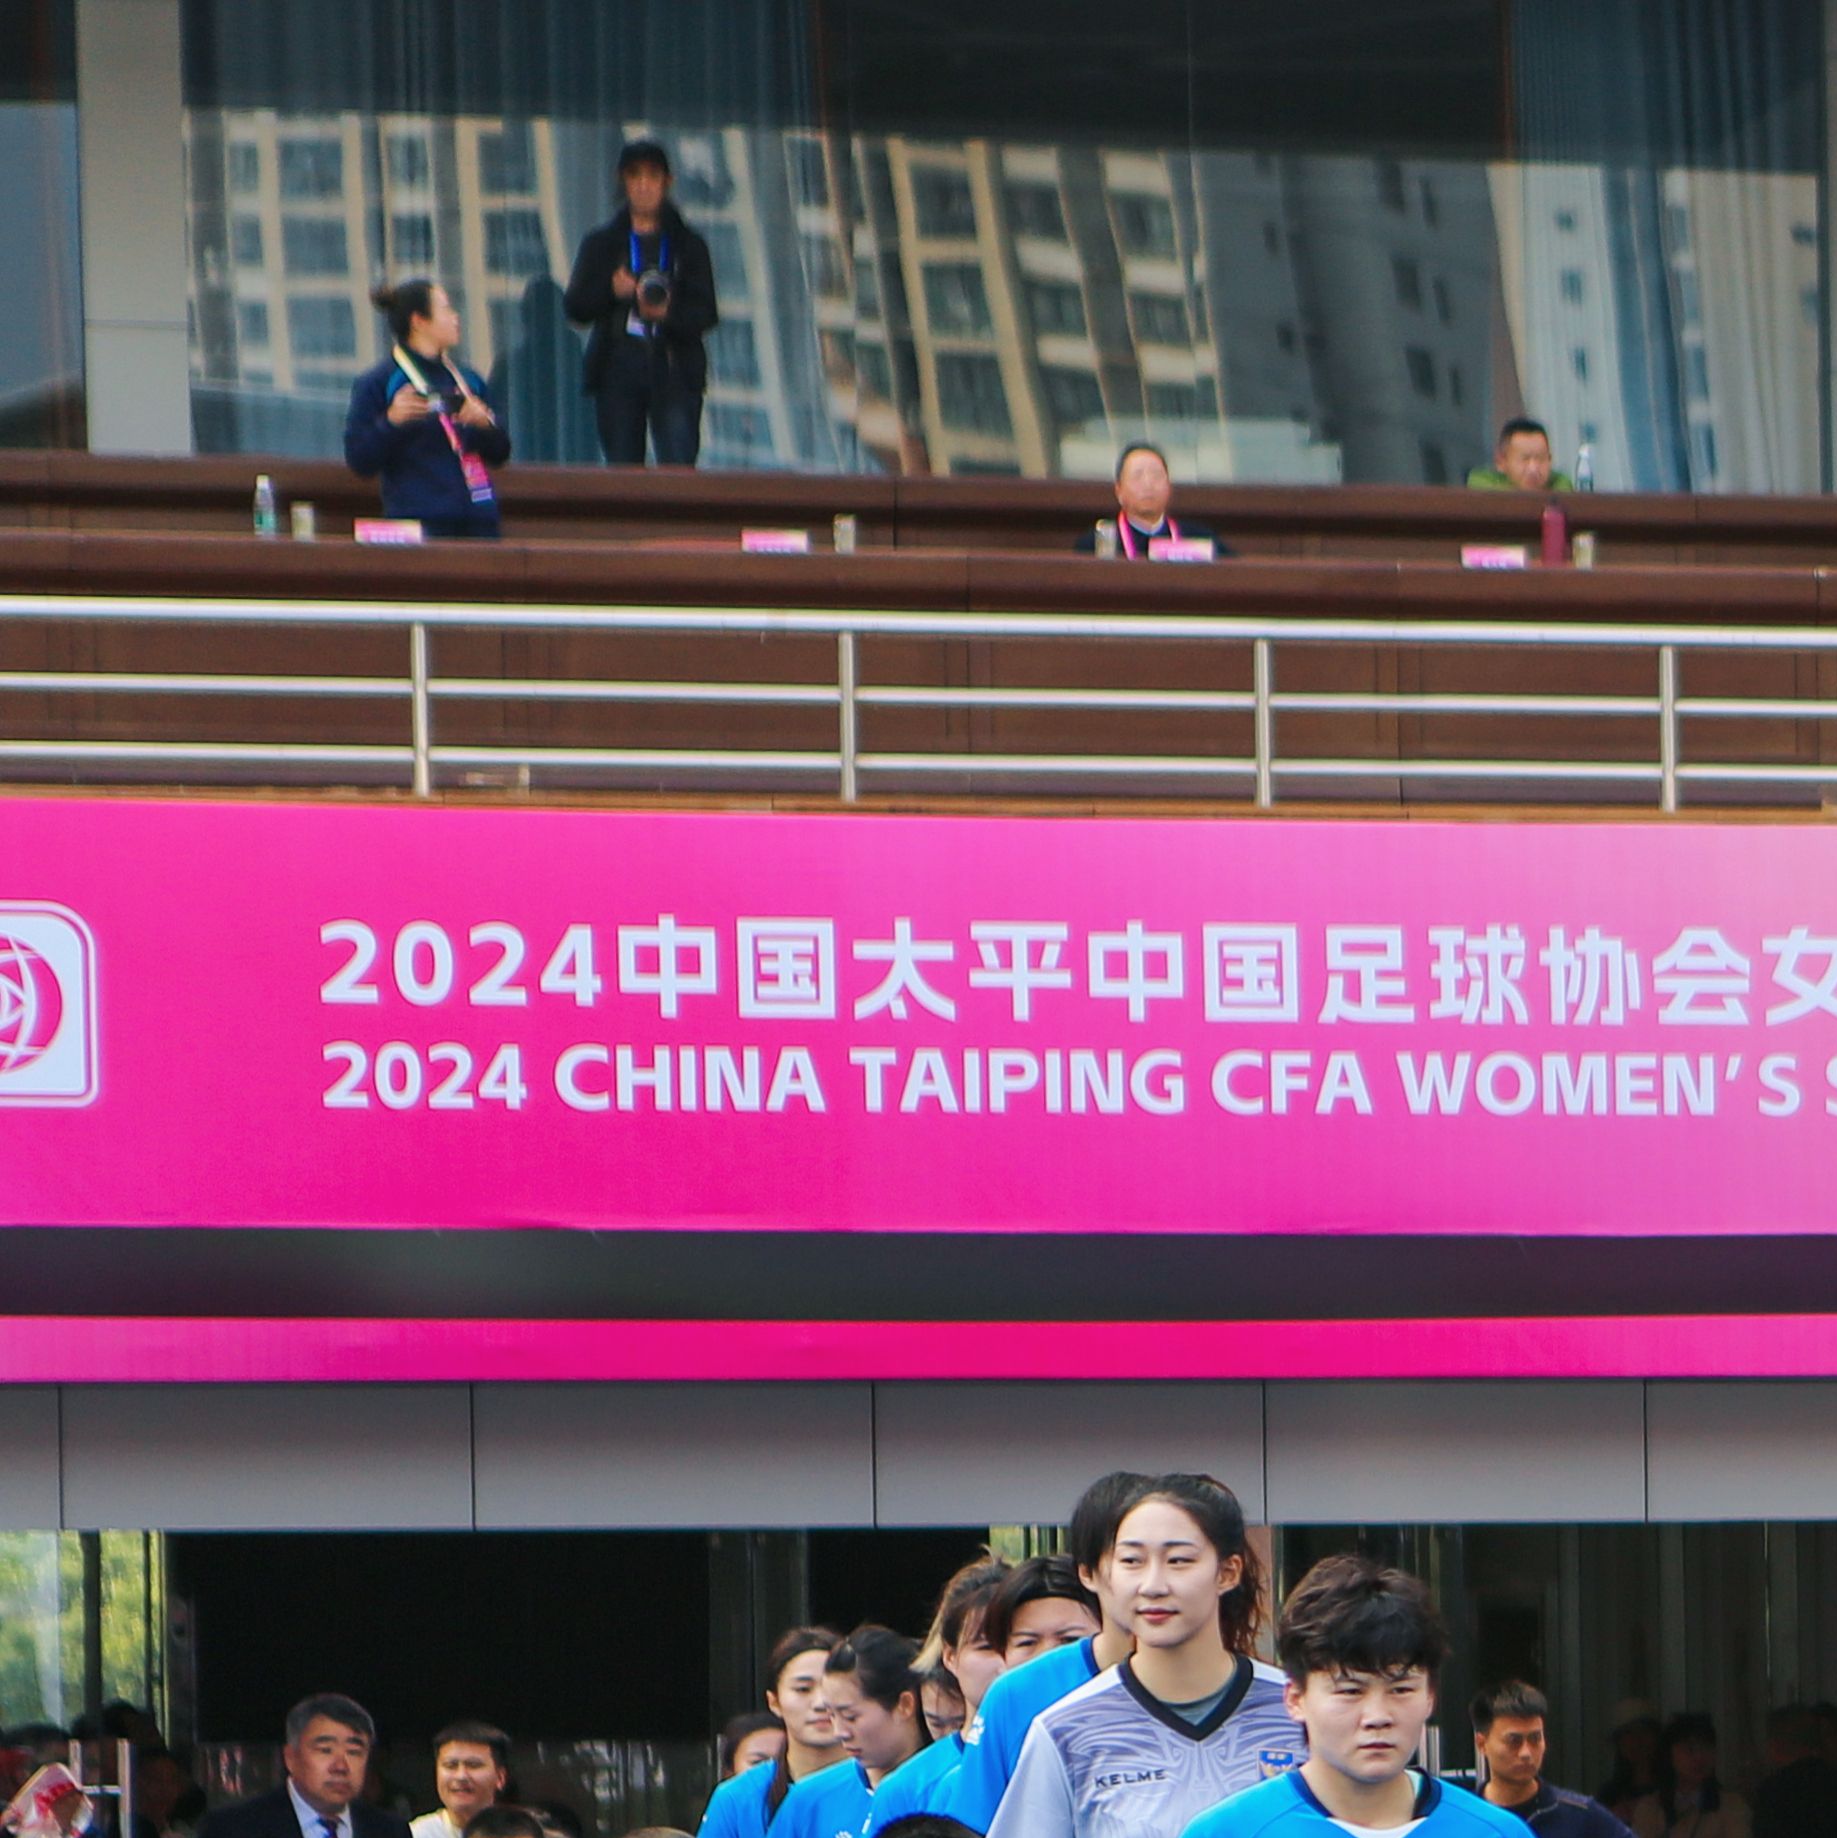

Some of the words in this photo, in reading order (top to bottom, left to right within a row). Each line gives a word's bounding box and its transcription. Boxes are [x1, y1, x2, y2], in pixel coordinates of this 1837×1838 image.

[320, 1039, 528, 1110] 2024
[553, 1044, 826, 1114] CHINA
[848, 1046, 1188, 1115] TAIPING
[1210, 1050, 1373, 1116] CFA
[1094, 1768, 1168, 1788] KELME
